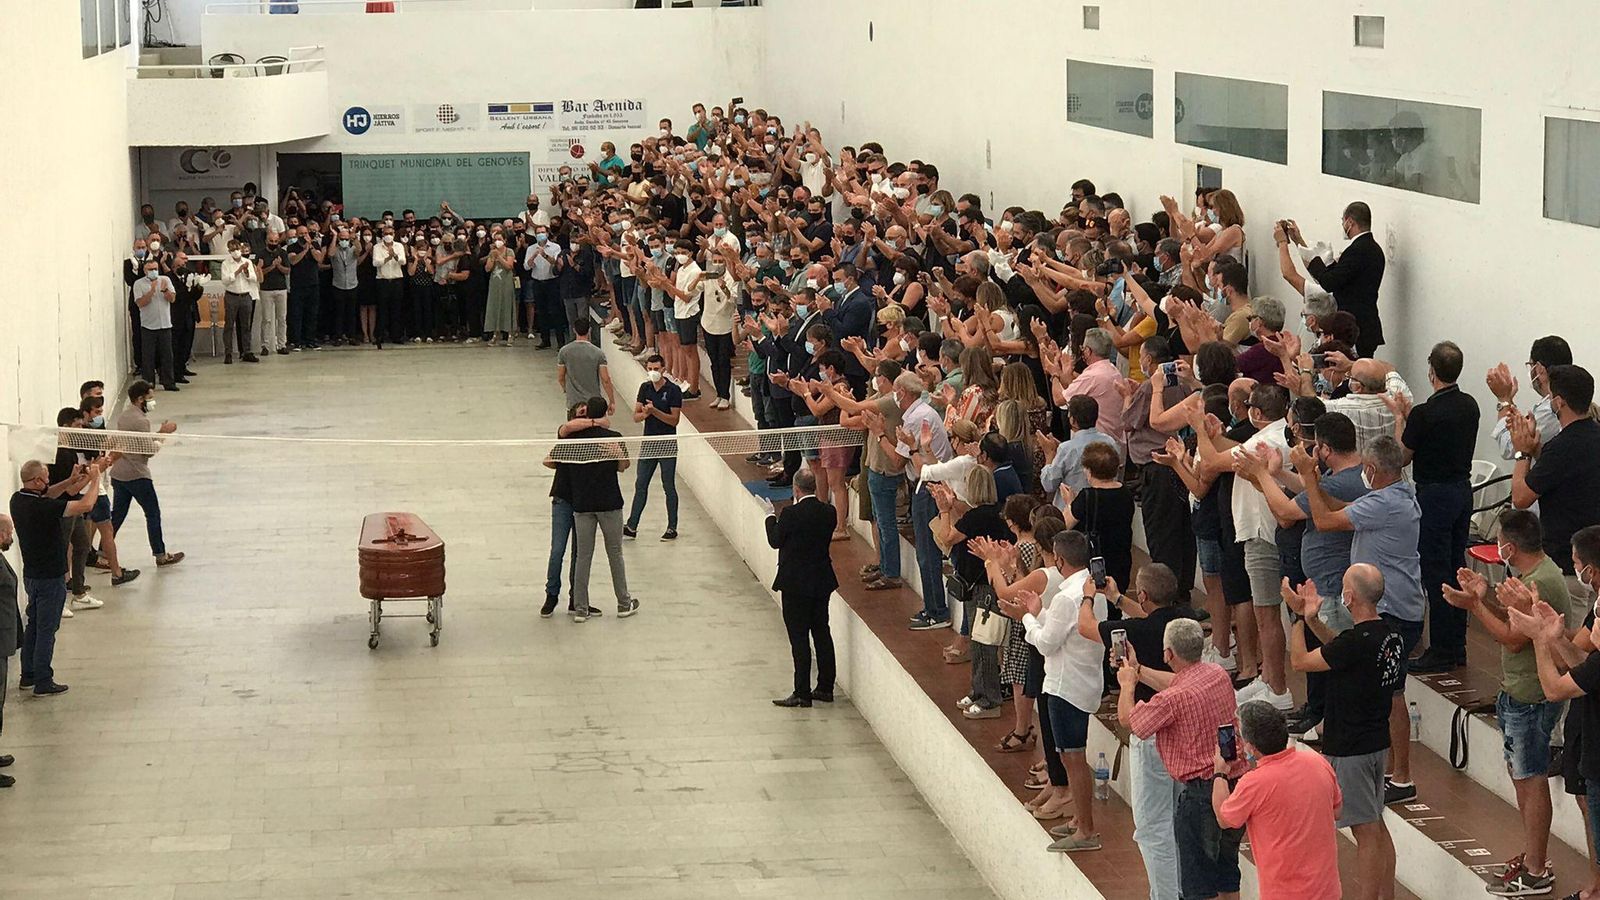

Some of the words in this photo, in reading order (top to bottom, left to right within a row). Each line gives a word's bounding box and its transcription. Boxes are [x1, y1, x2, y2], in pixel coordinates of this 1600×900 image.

[561, 99, 589, 113] Bar
[593, 99, 642, 112] Avenida
[346, 113, 367, 128] HJ
[349, 159, 396, 170] TRINQUET
[400, 158, 452, 169] MUNICIPAL
[457, 157, 473, 168] DEL
[477, 156, 525, 167] GENOVÉS
